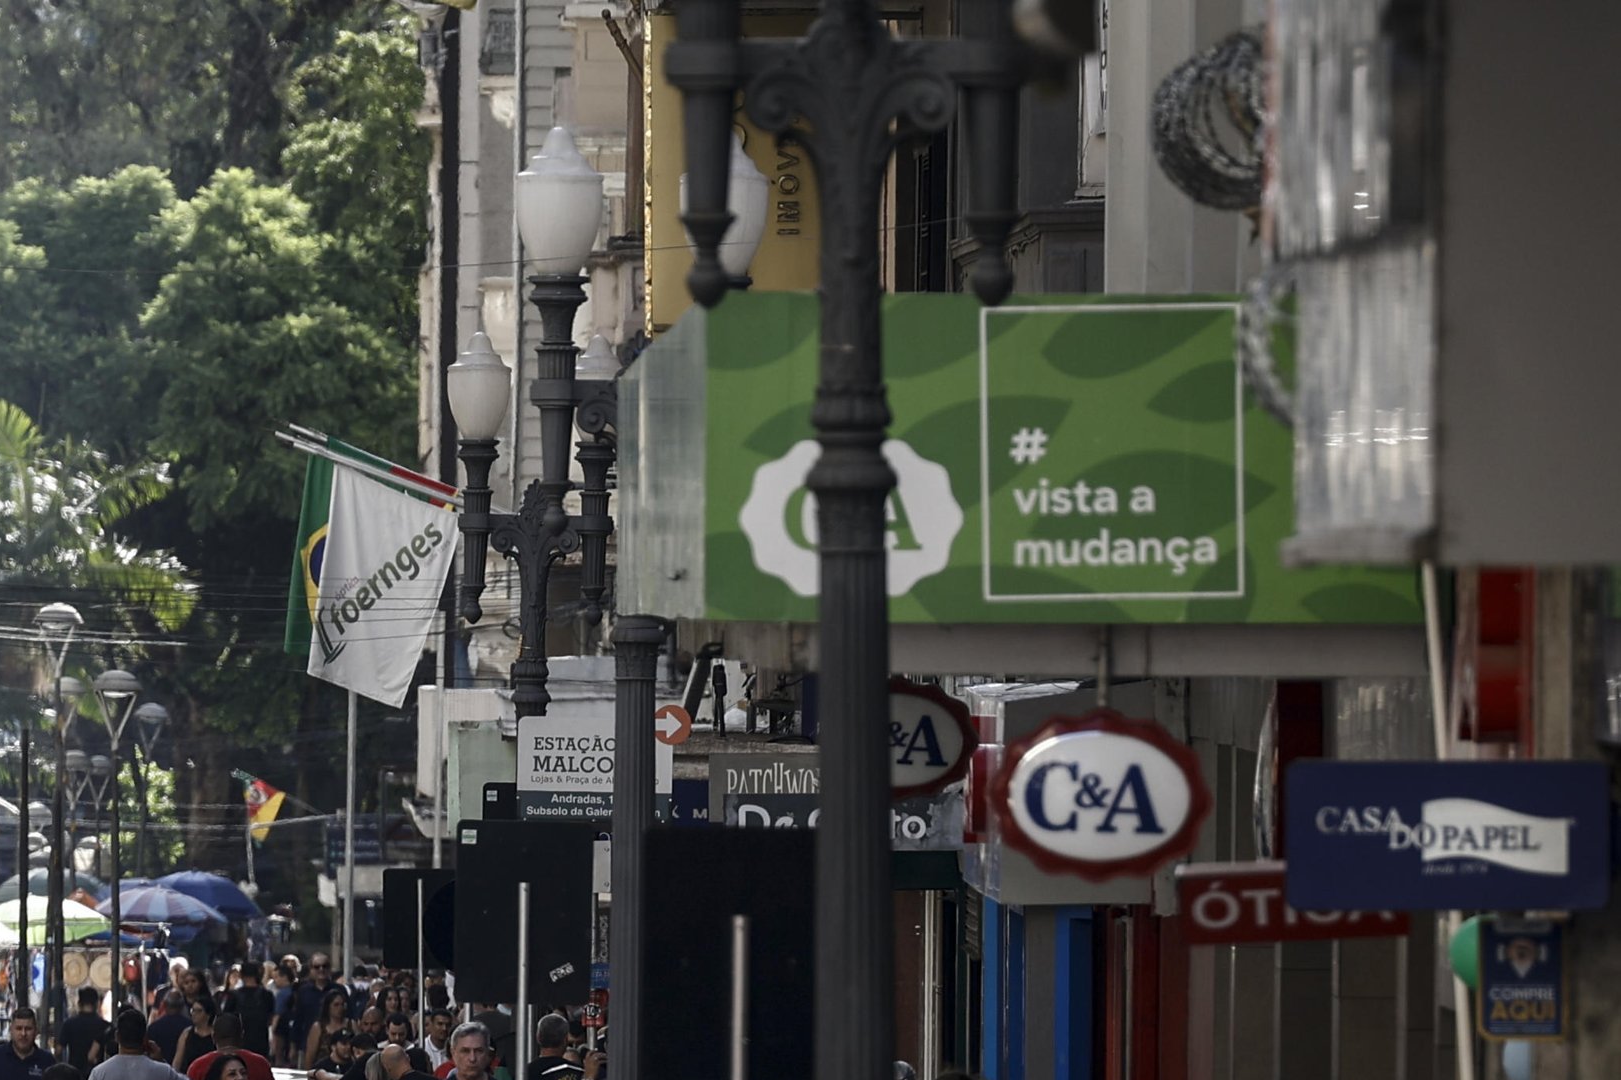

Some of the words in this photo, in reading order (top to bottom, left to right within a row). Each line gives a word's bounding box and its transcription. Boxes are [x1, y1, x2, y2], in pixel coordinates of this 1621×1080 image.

[1013, 477, 1119, 515] vista
[1128, 484, 1157, 514] a
[1013, 527, 1218, 576] mudança
[329, 521, 444, 637] foernges
[533, 735, 616, 755] ESTAÇÃO
[532, 755, 614, 774] MALCO
[530, 775, 554, 785] Lojas
[565, 776, 589, 786] Praça
[592, 776, 603, 785] de
[551, 793, 606, 806] Andradas,
[1023, 762, 1164, 835] C&A
[526, 805, 568, 817] Subsolo
[570, 806, 583, 817] da
[1315, 806, 1404, 834] CASA
[1388, 826, 1437, 851] DO
[1439, 824, 1542, 852] PAPEL
[1488, 986, 1557, 1001] COMPRE
[1489, 1001, 1556, 1021] AQUI
